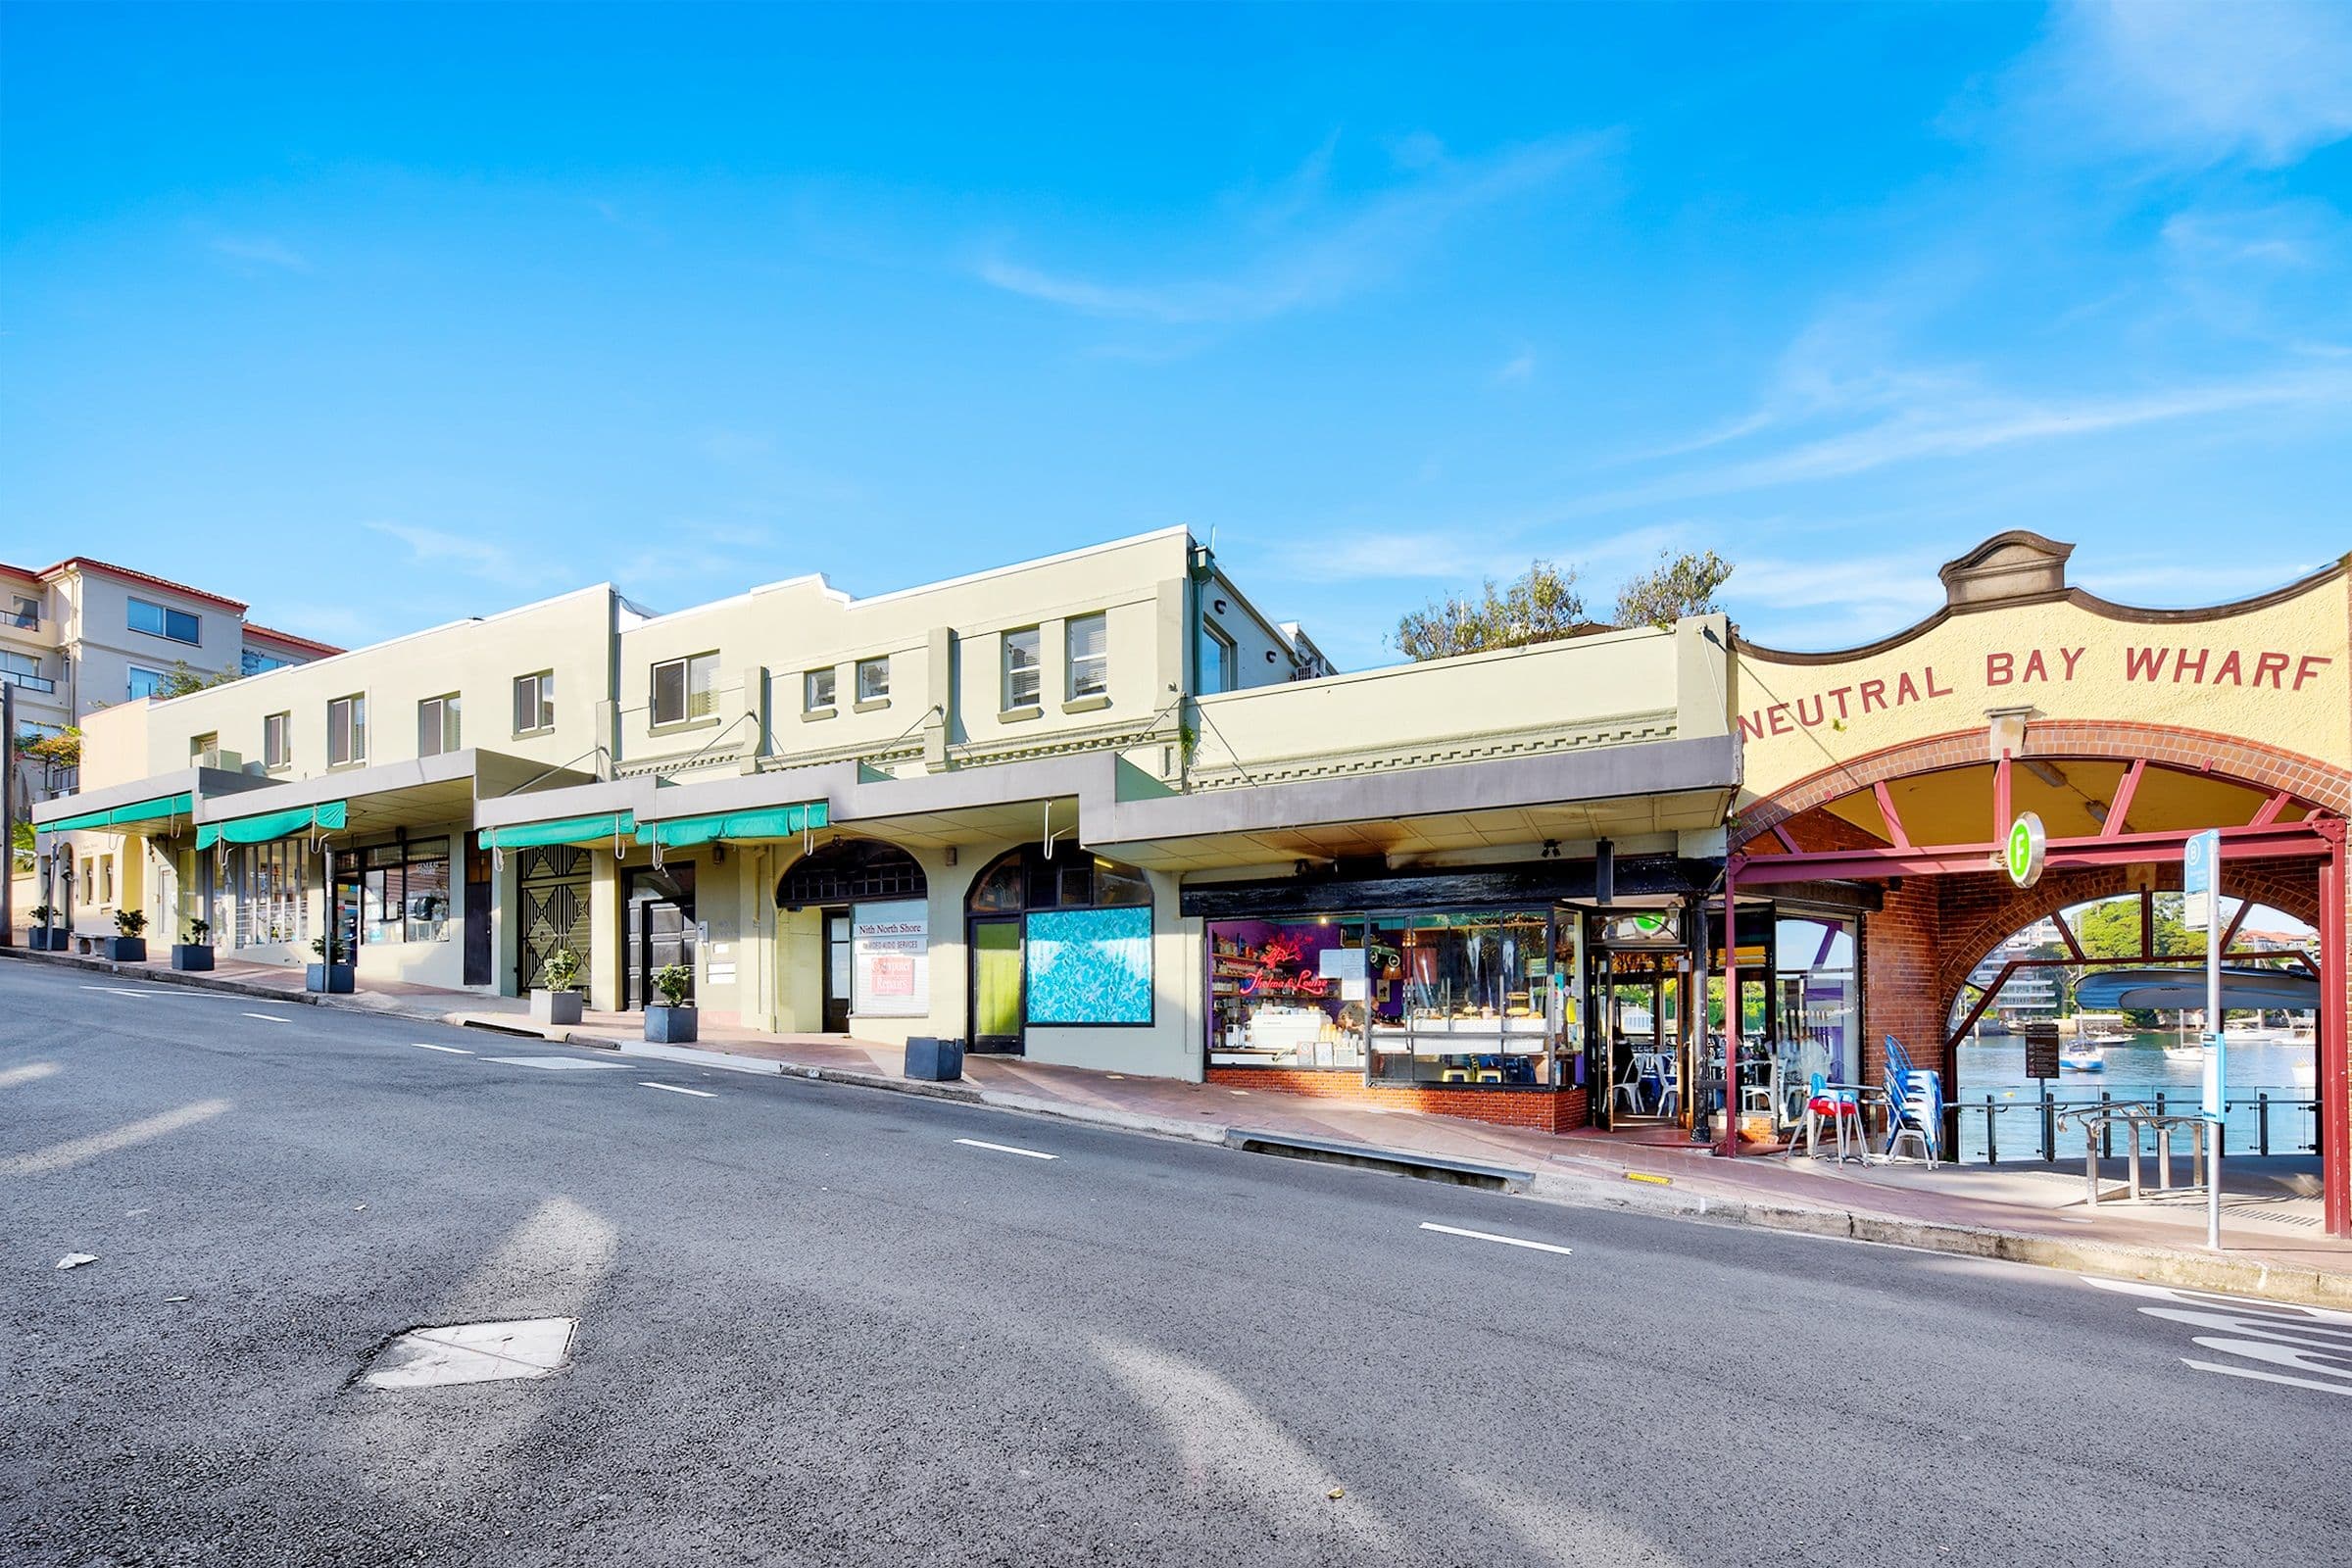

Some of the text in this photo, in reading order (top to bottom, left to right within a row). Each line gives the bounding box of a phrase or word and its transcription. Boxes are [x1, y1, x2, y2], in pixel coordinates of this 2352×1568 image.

[1737, 647, 2332, 744] NEUTRAL BAY WHARF
[2016, 833, 2025, 869] F
[876, 923, 899, 934] North
[900, 923, 921, 933] Shore
[897, 940, 918, 950] SERVICES
[1240, 967, 1284, 994] Thelma
[1293, 969, 1328, 995] Louise
